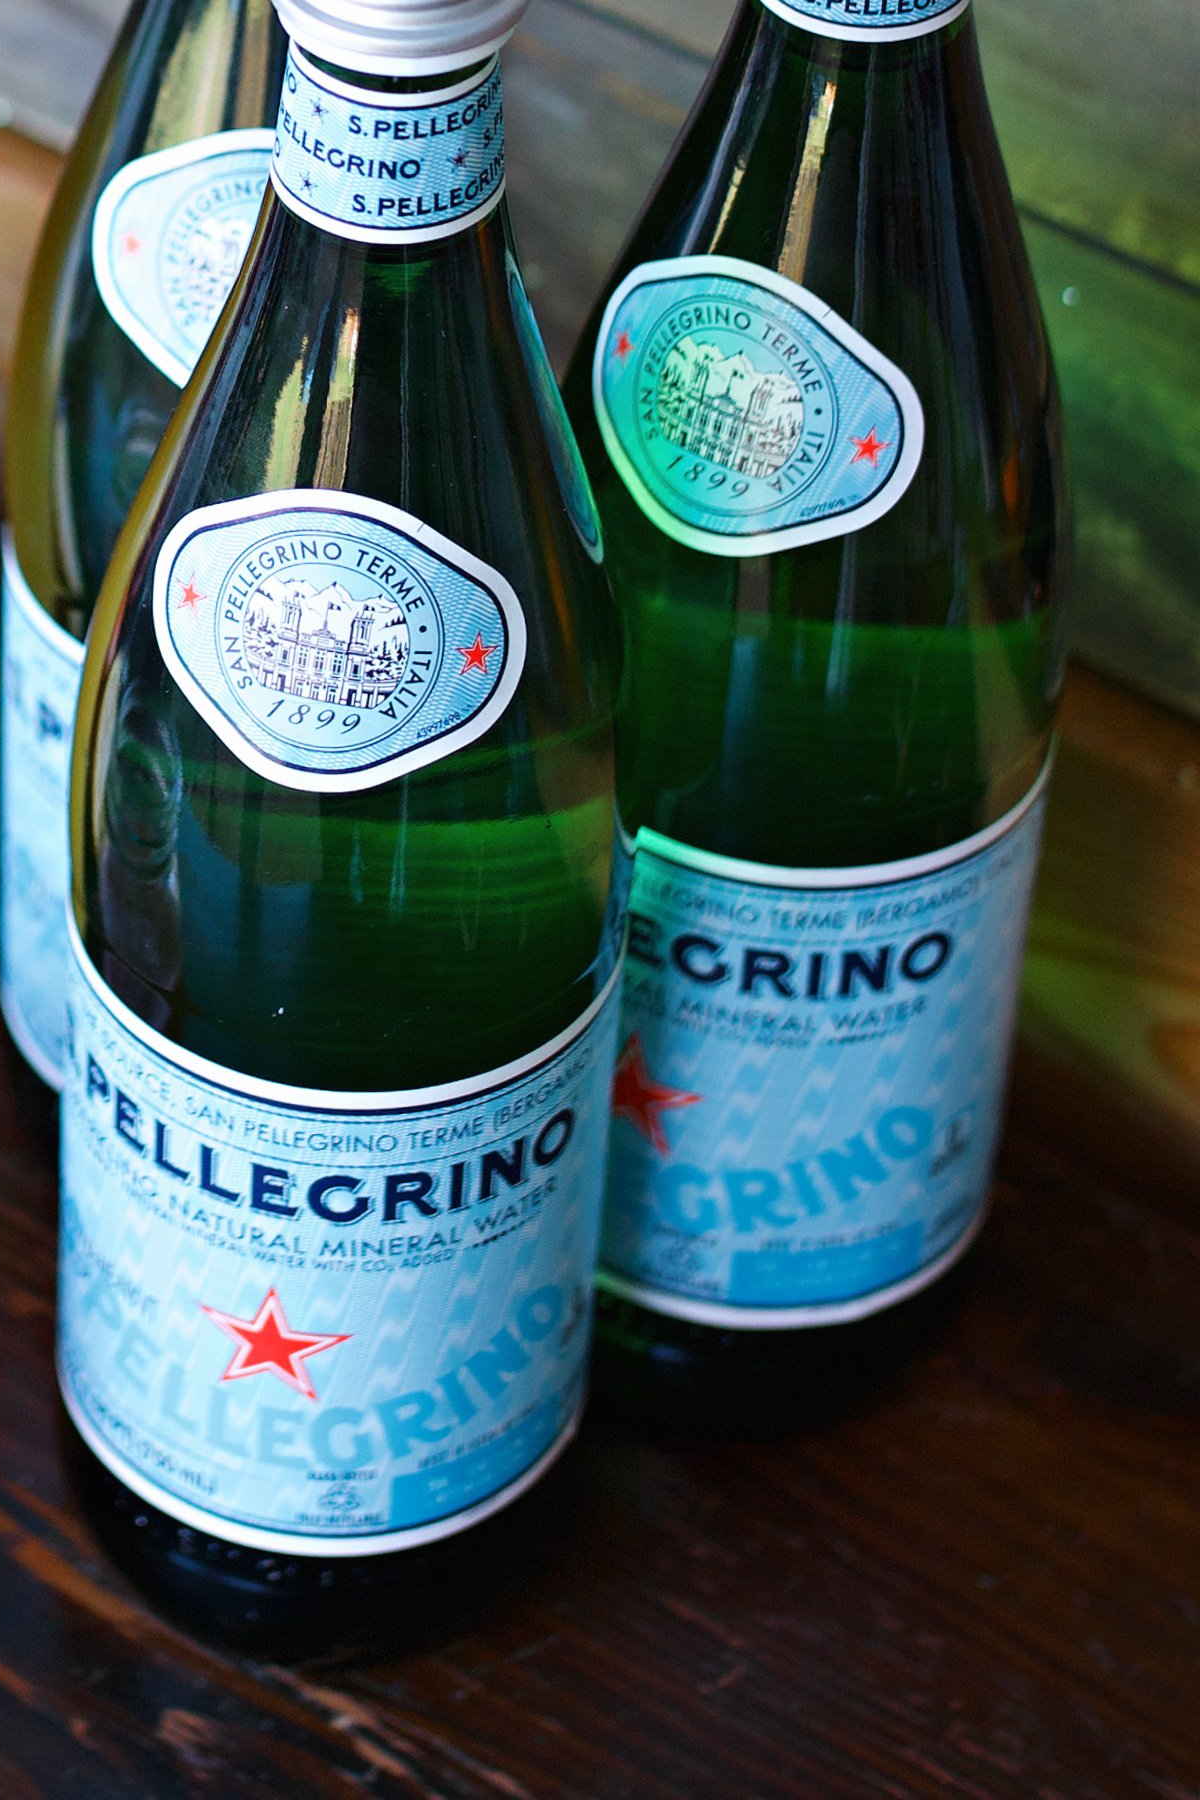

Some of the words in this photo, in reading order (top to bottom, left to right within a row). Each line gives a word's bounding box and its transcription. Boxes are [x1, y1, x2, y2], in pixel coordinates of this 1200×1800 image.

[643, 304, 752, 377] PELLEGRINO
[761, 322, 824, 395] TERME
[641, 389, 661, 441] SAN
[666, 455, 751, 499] 1899
[769, 431, 826, 495] ITALIA
[224, 540, 342, 624] PELLEGRINO
[356, 549, 425, 614] TERME
[224, 636, 254, 690] SAN
[378, 650, 432, 721] ITALIA
[266, 699, 362, 735] 1899
[244, 1119, 399, 1155] PELLEGRINO
[408, 1115, 485, 1151] TERME
[168, 1193, 305, 1256] NATURAL
[319, 1226, 461, 1258] MINERAL
[473, 1175, 558, 1234] WATER
